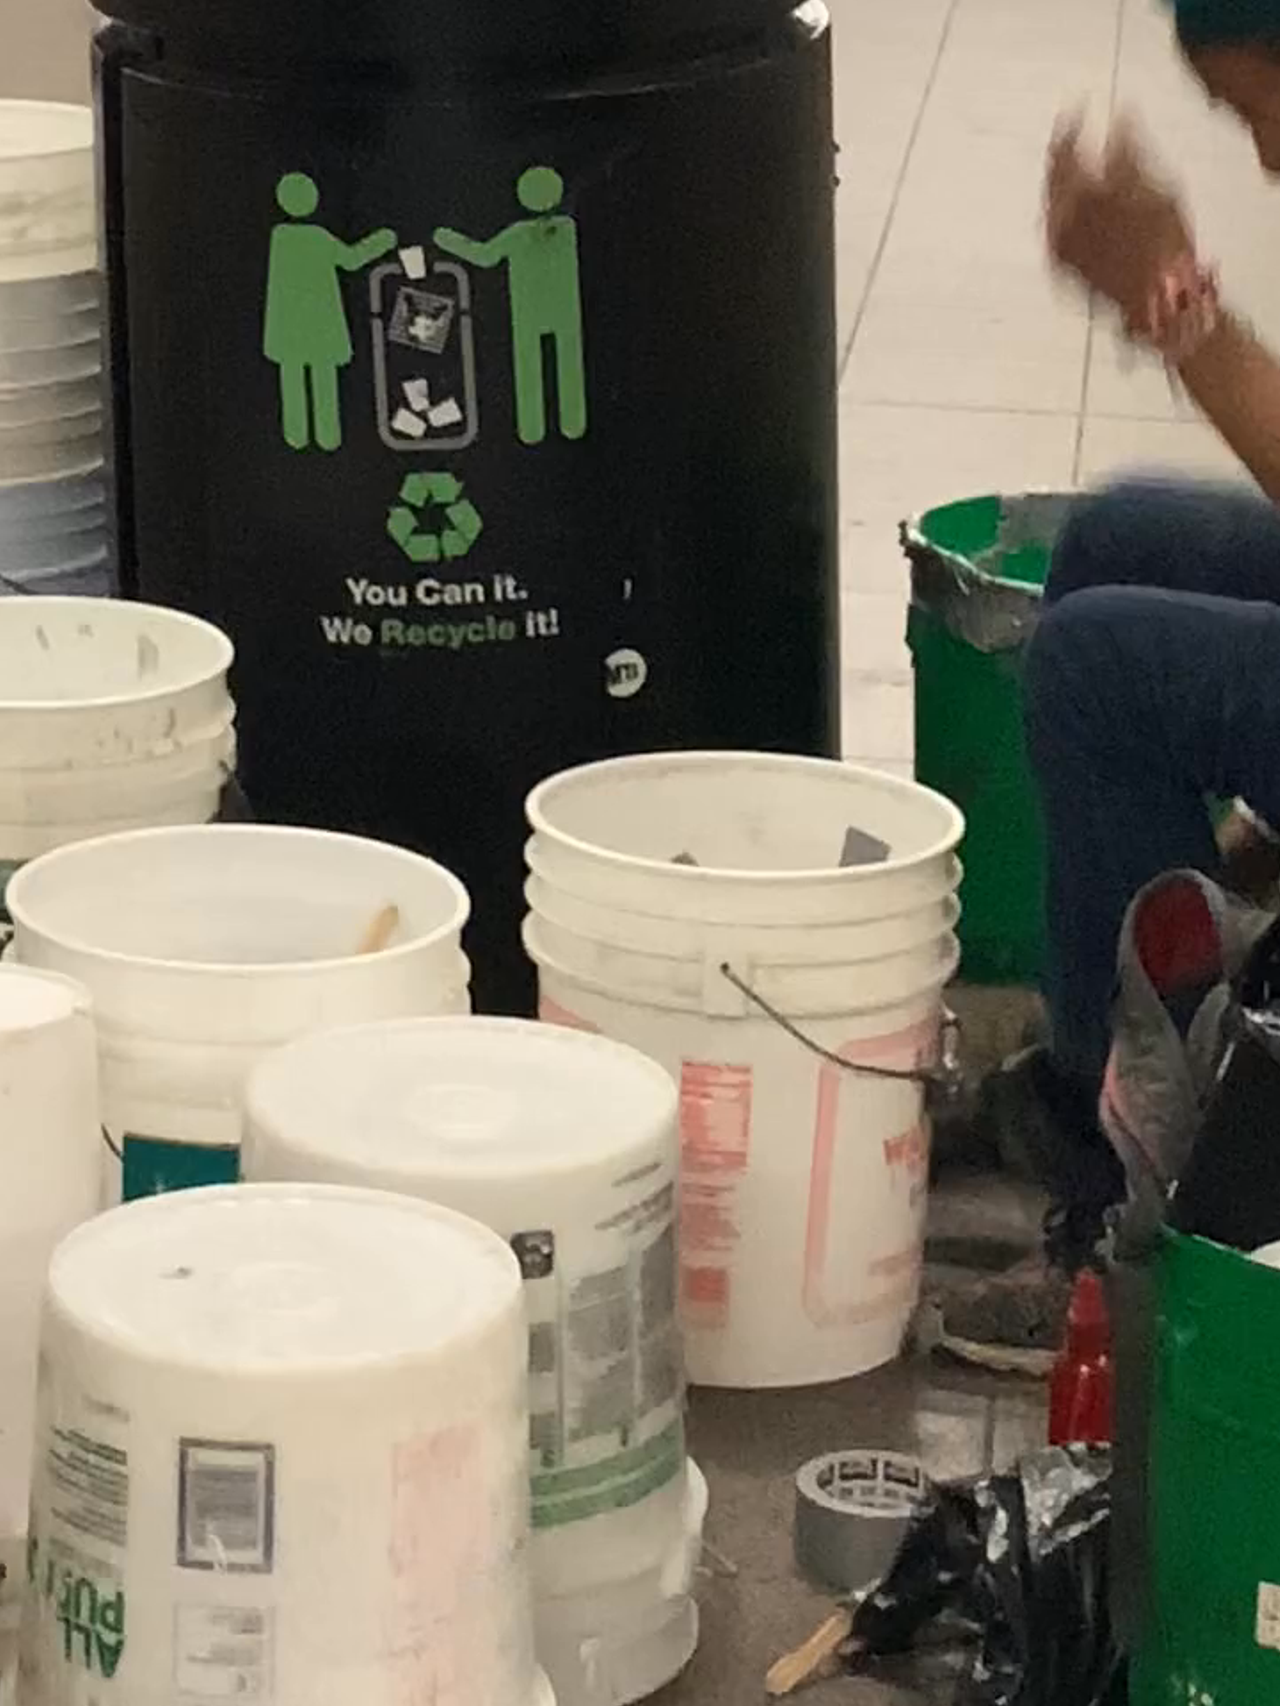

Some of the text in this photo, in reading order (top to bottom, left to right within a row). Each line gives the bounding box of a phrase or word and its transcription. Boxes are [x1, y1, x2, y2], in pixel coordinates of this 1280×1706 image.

[345, 573, 529, 606] You Can It.
[321, 607, 561, 649] We Recycle It!
